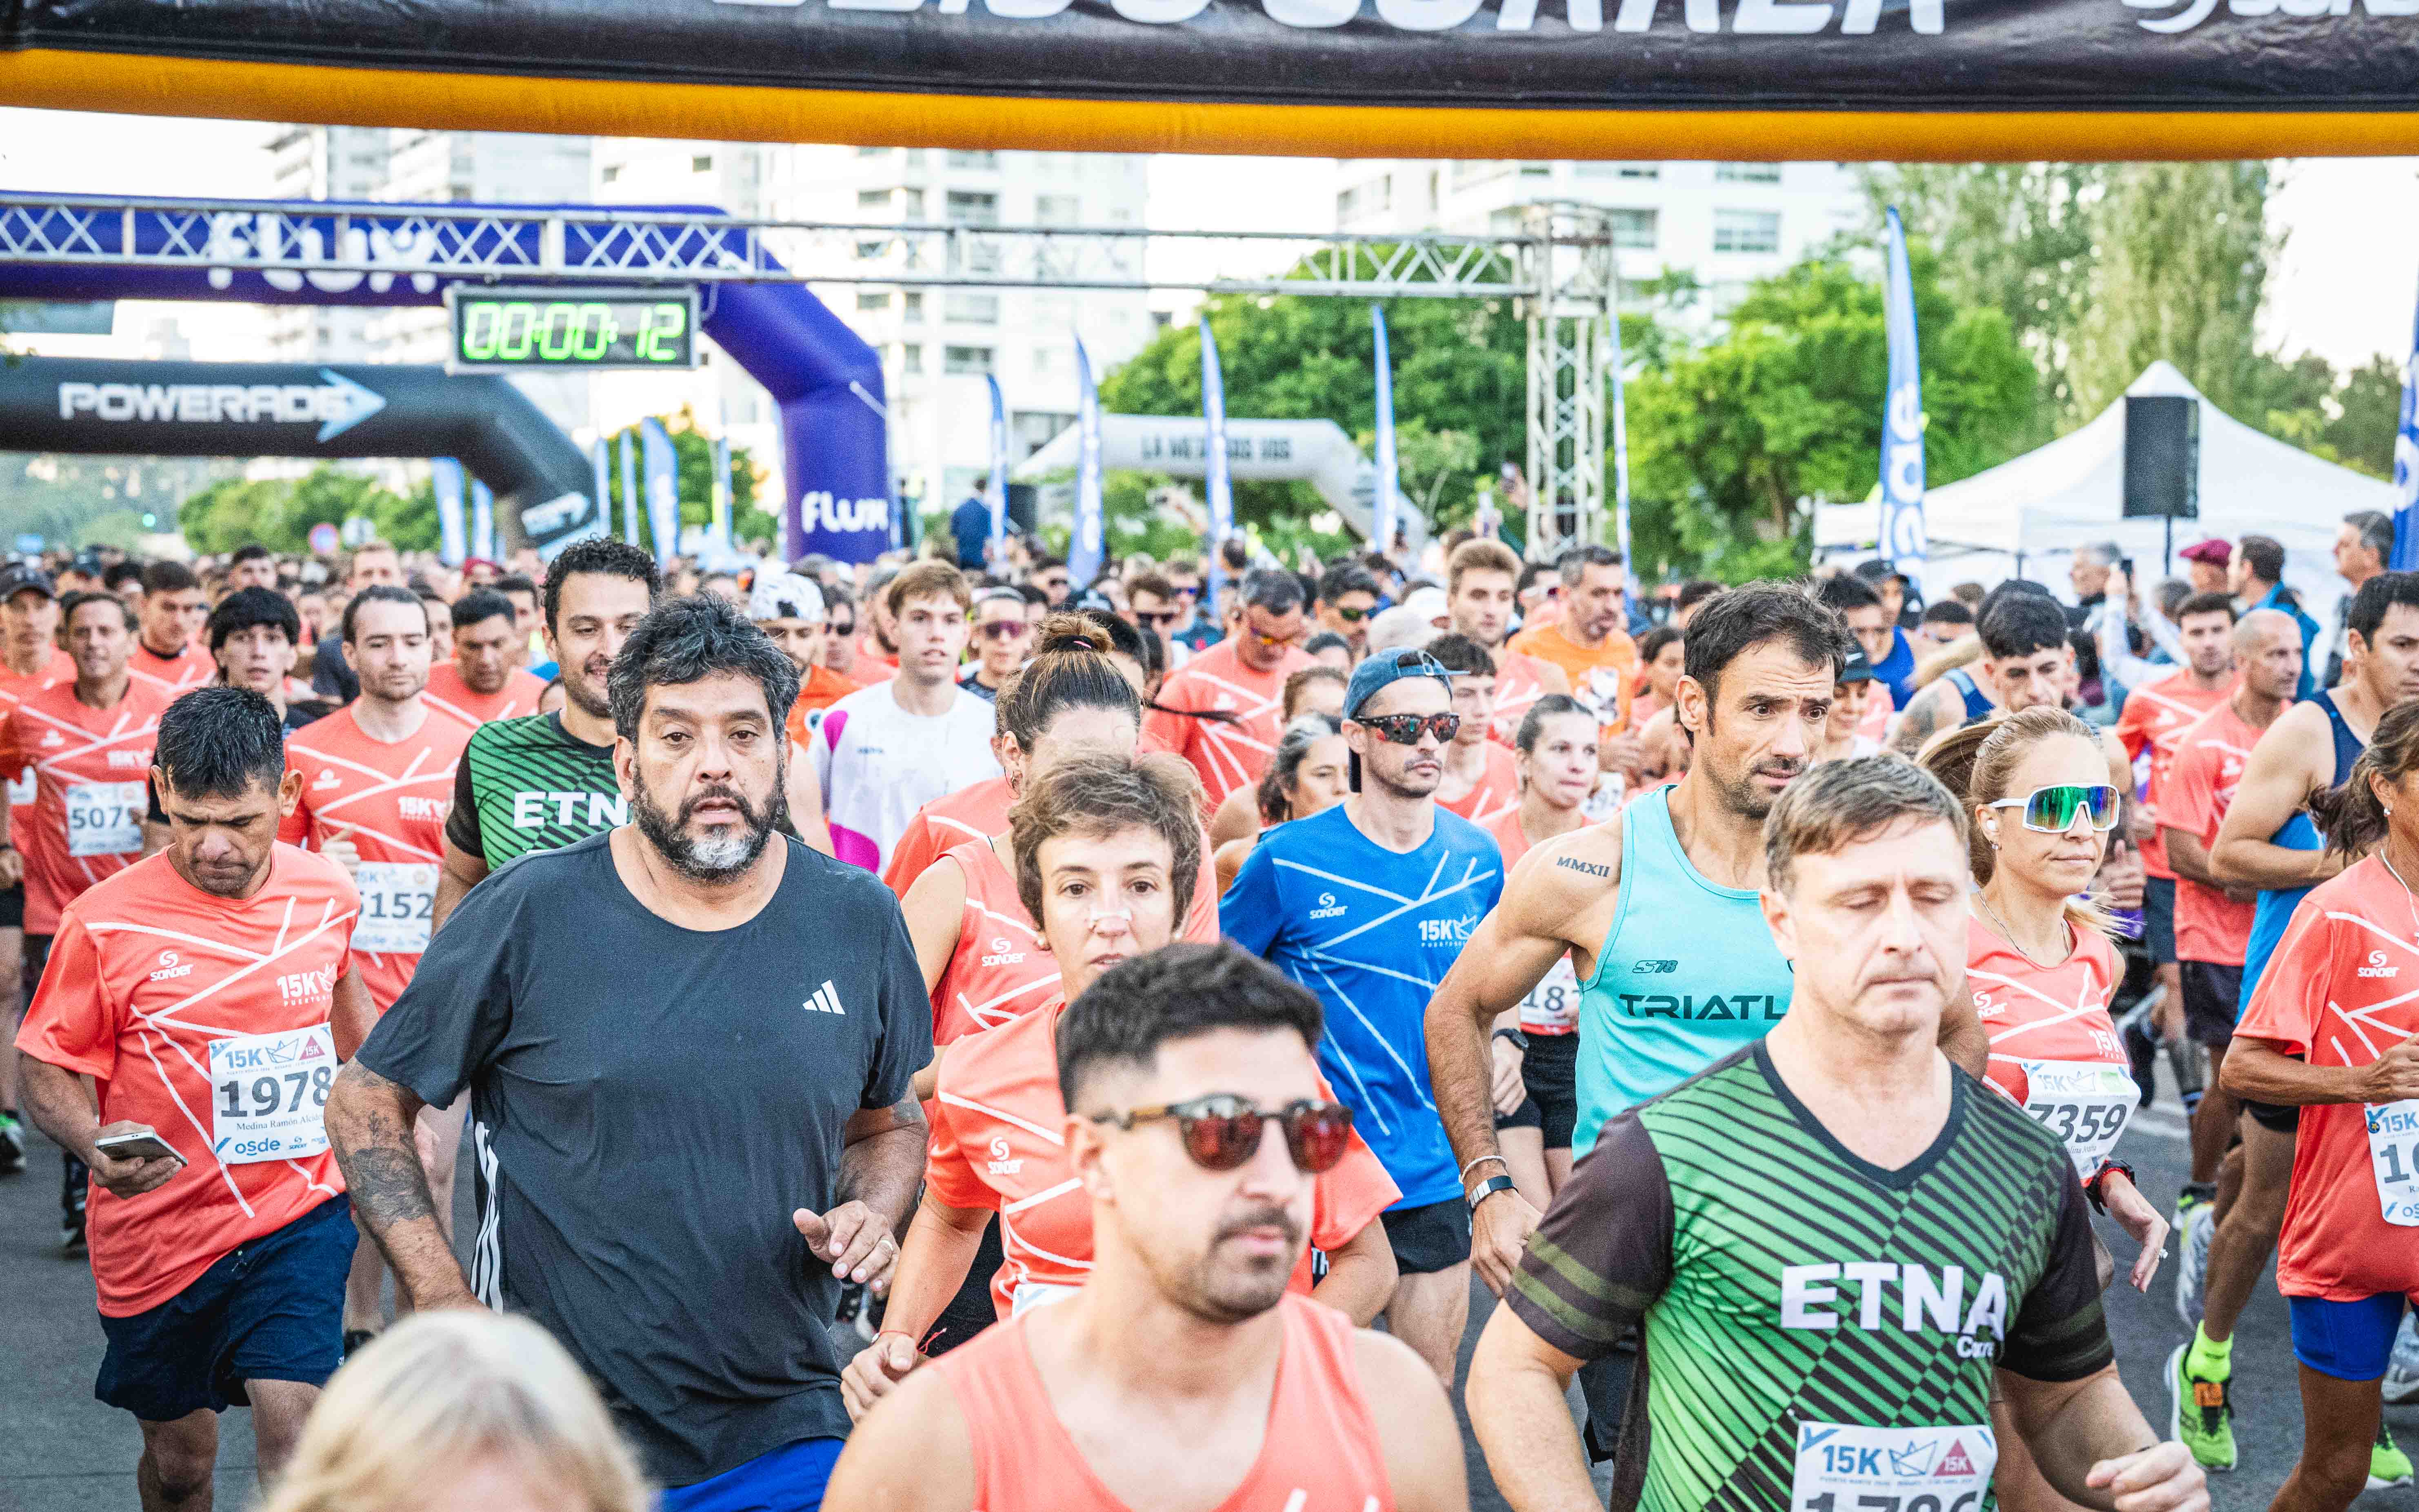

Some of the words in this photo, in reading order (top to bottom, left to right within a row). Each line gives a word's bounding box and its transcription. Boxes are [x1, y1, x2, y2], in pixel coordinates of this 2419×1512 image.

[463, 302, 685, 361] 00:00:12
[58, 383, 347, 422] POWERADE
[71, 805, 134, 830] 507
[514, 791, 633, 828] ETN
[1557, 856, 1610, 877] MMXII
[1418, 919, 1453, 941] 15K
[1633, 960, 1678, 973] S78
[276, 972, 319, 999] 15K
[225, 1048, 263, 1069] 15K
[306, 1045, 320, 1056] 15K
[220, 1066, 332, 1117] 1978
[236, 1122, 268, 1131] Medina
[270, 1118, 298, 1128] Ramón
[2028, 1103, 2127, 1143] 7359
[2382, 1112, 2419, 1133] 15K
[235, 1137, 281, 1156] osde
[2380, 1141, 2419, 1183] 1
[1781, 1261, 2008, 1342] ETNA
[1823, 1444, 1882, 1476] 15K
